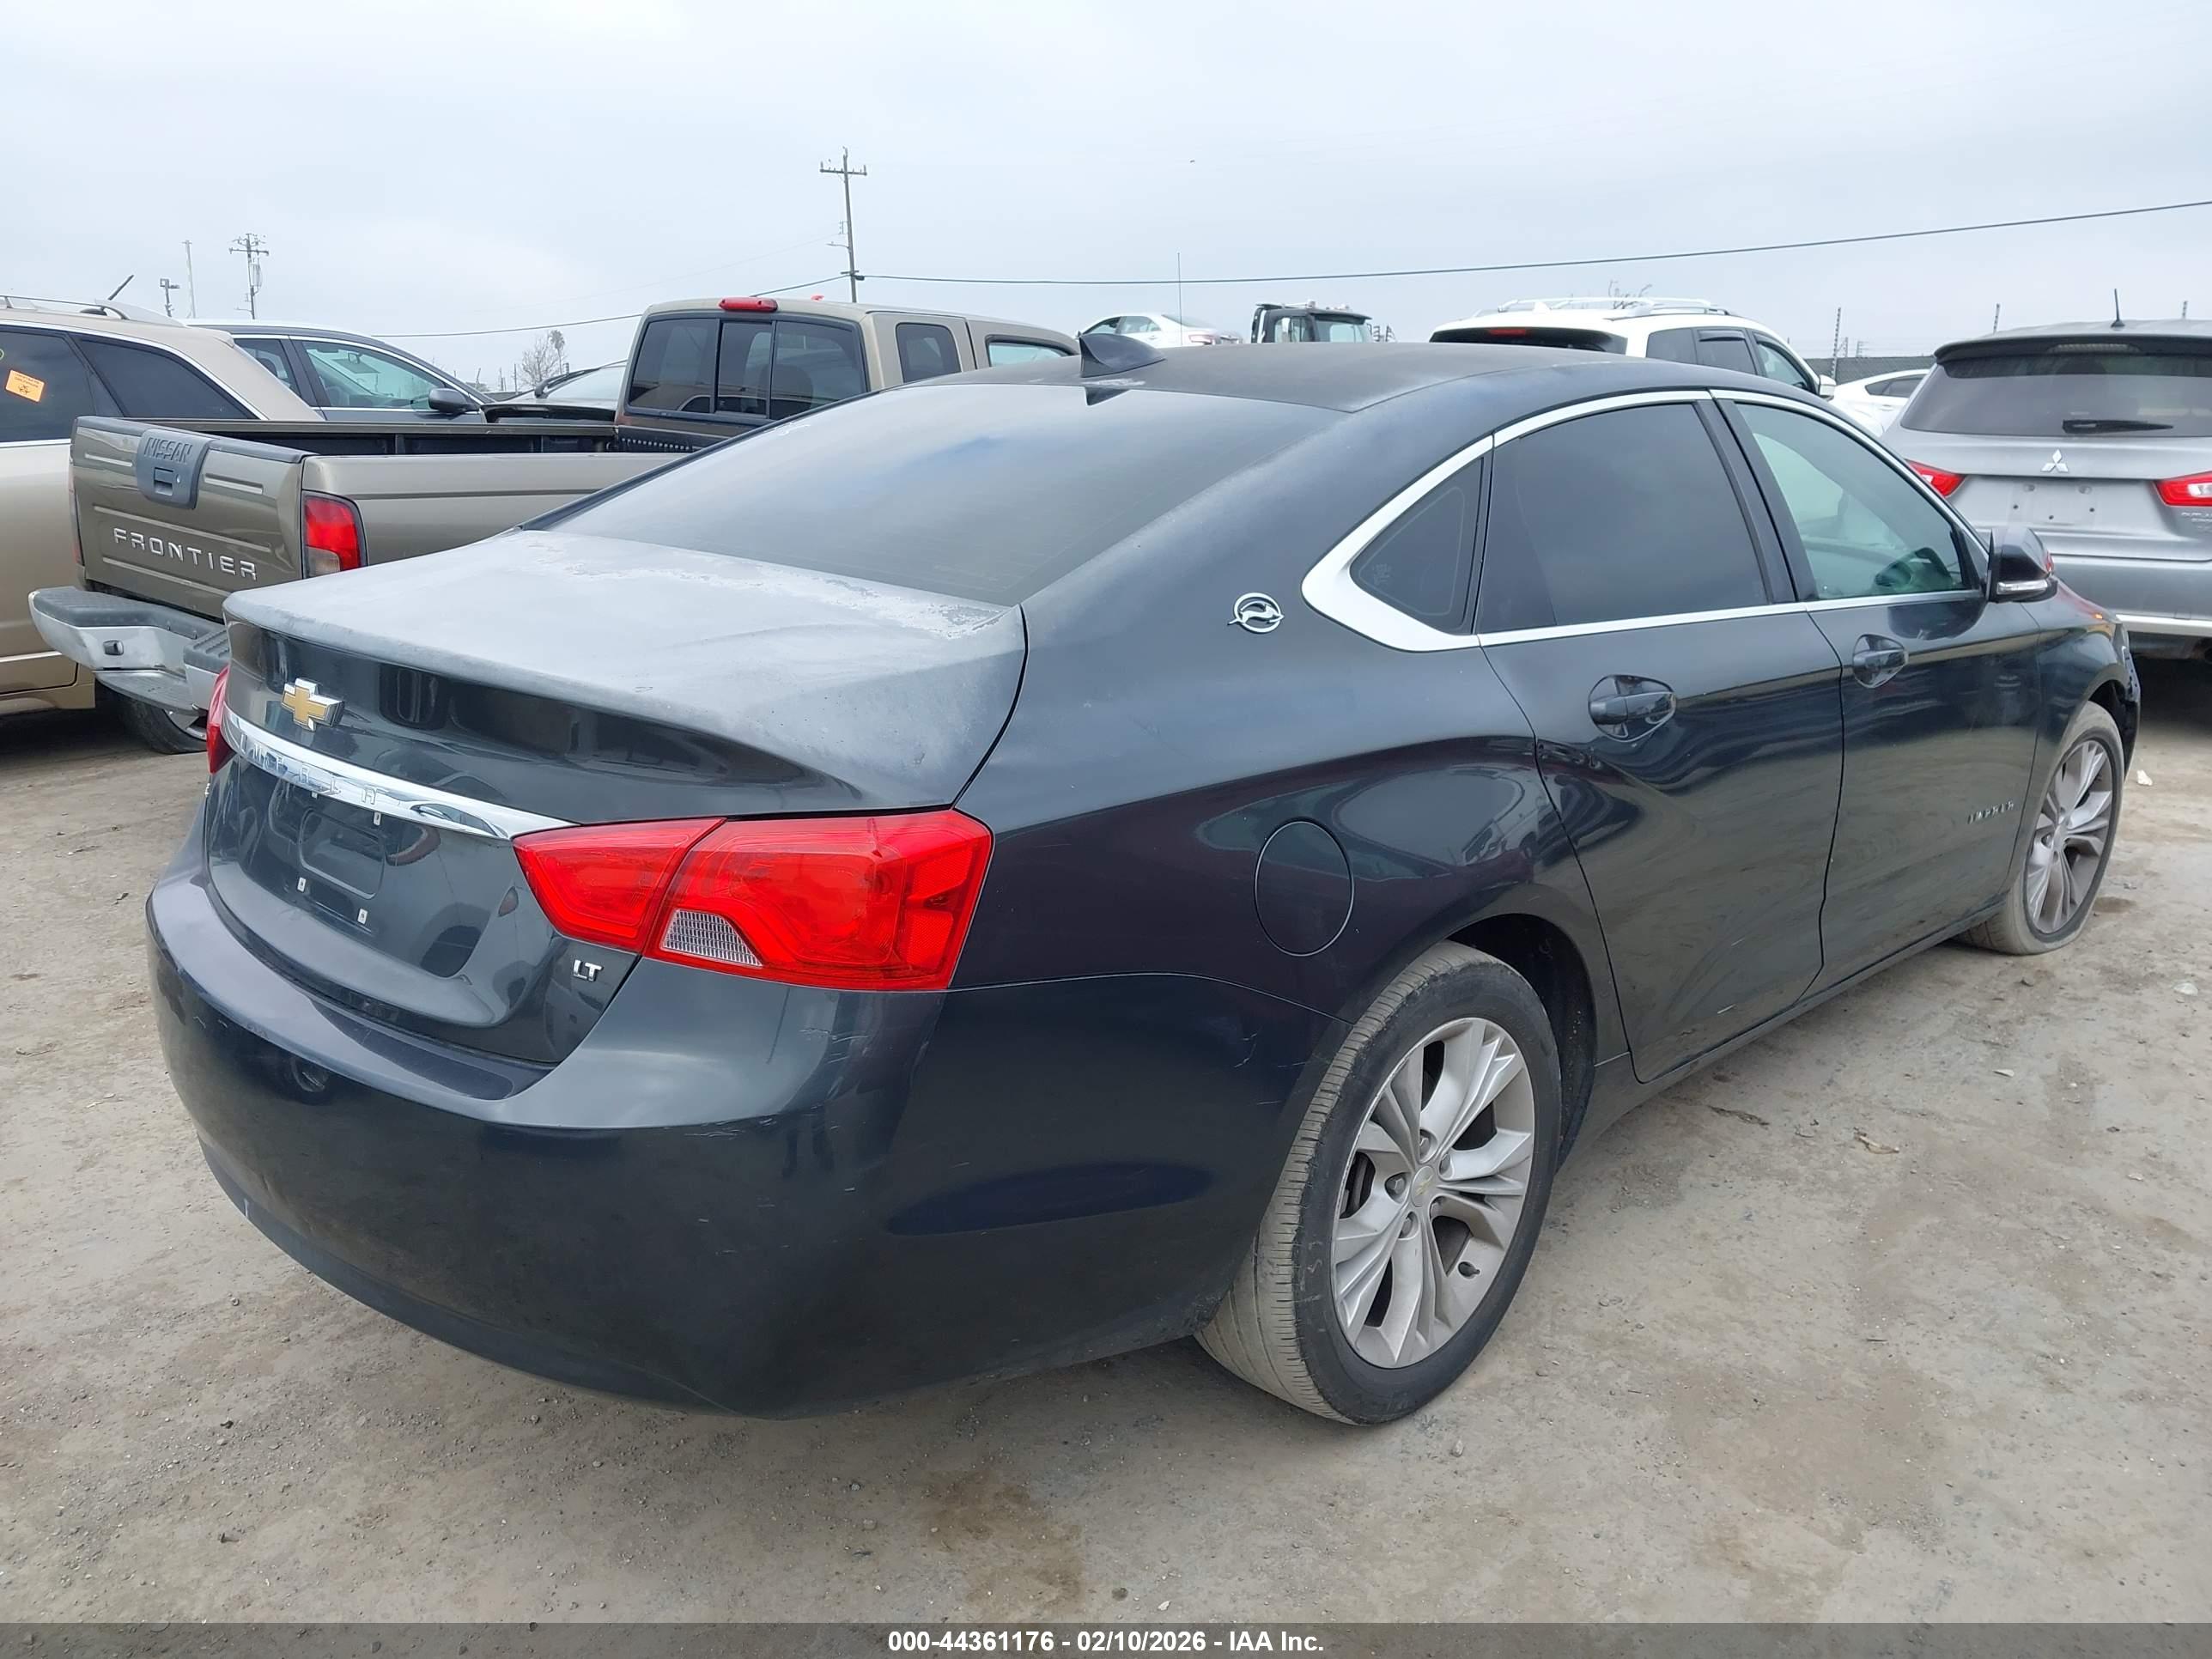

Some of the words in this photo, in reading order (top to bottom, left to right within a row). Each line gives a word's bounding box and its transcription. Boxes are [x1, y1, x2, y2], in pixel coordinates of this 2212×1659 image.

[144, 437, 193, 464] NISSAN
[113, 527, 258, 581] FRONTIER
[240, 733, 376, 805] IMPALA
[573, 959, 603, 981] LT
